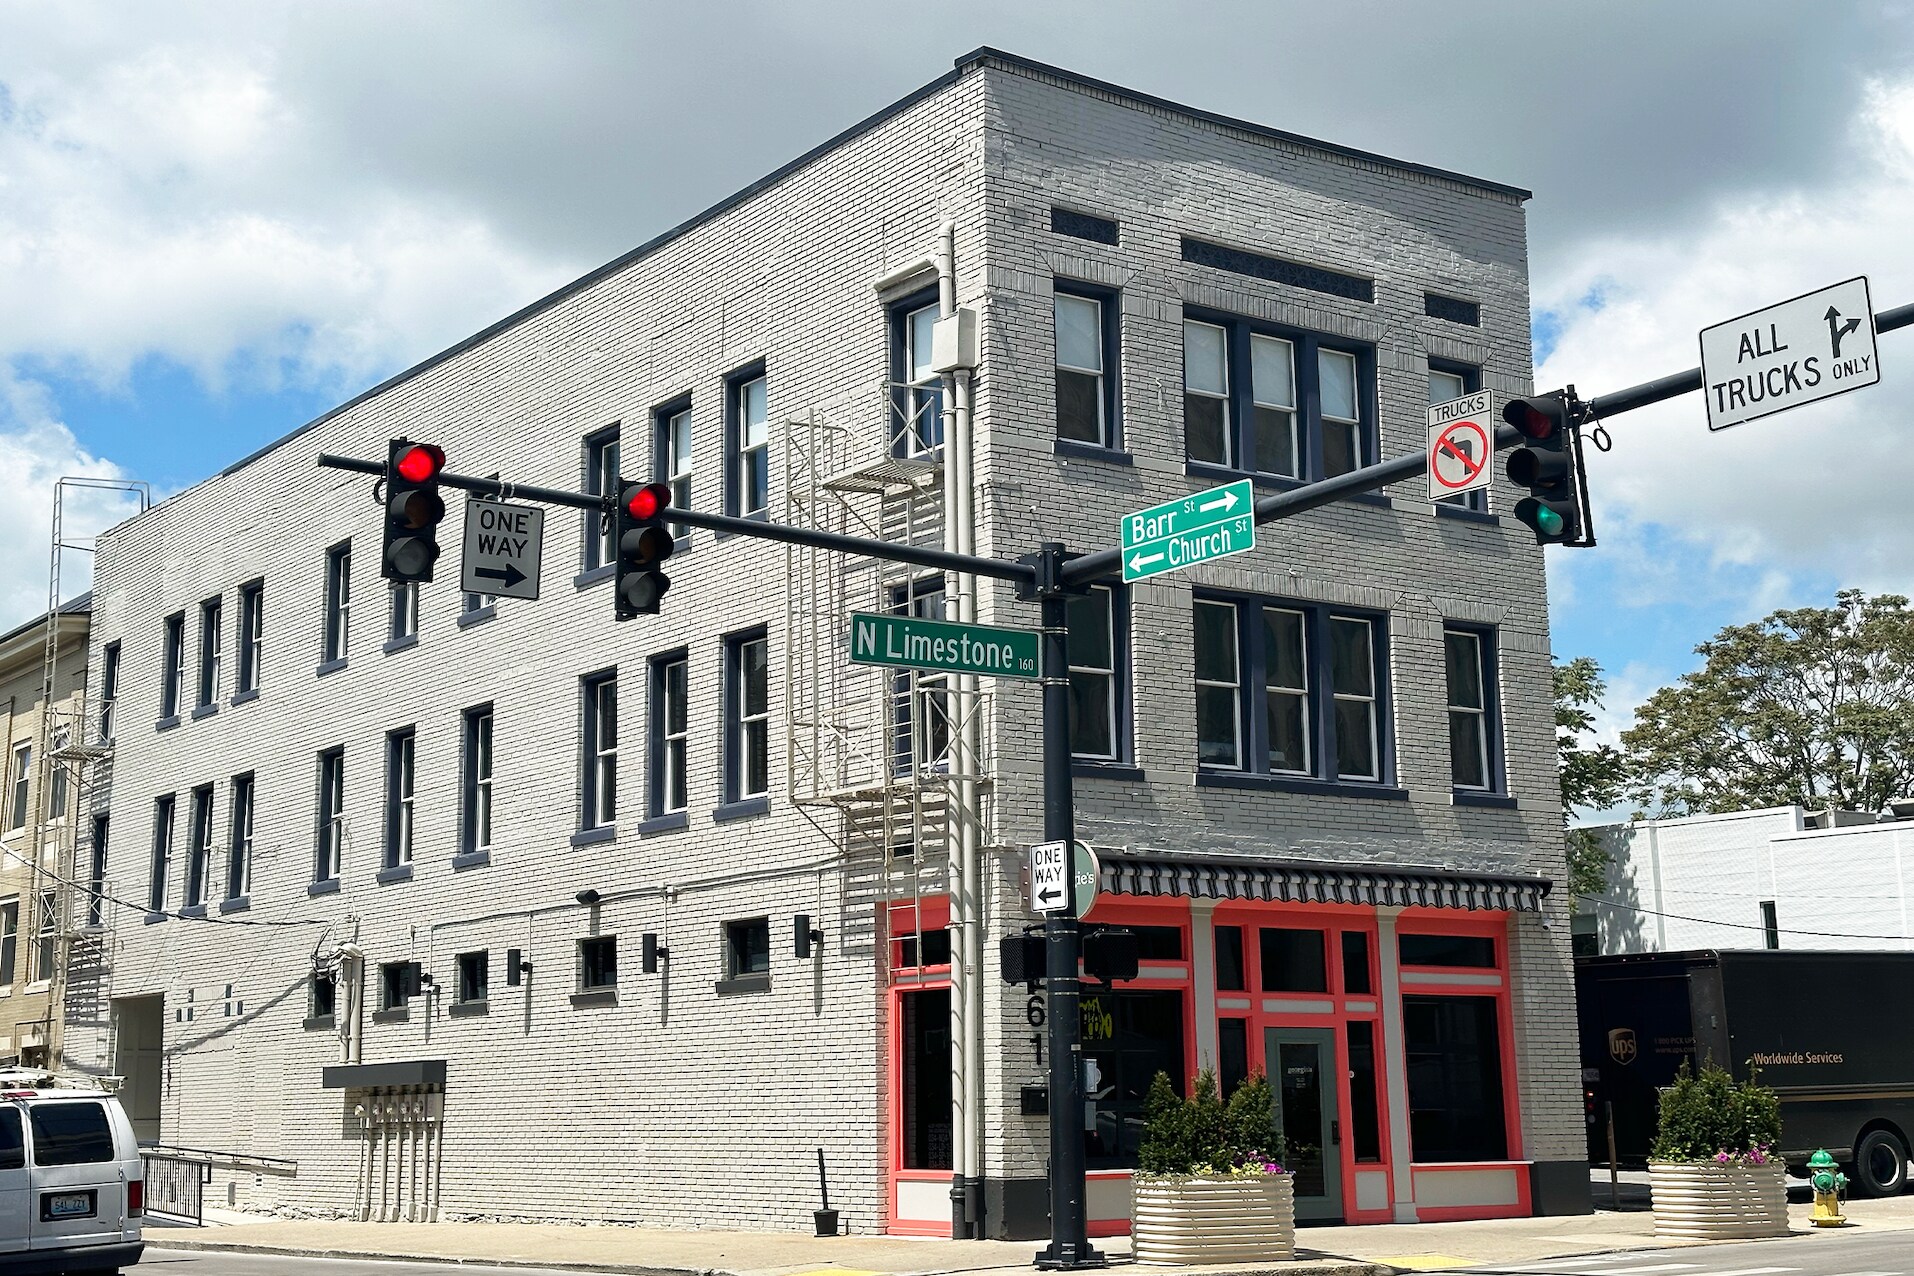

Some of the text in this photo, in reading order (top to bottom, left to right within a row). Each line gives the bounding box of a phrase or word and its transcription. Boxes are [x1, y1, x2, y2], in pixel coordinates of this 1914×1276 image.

[1737, 323, 1789, 364] ALL
[1832, 354, 1871, 380] ONLY
[1712, 357, 1821, 413] TRUCKS
[1434, 396, 1485, 421] TRUCKS
[480, 509, 529, 535] ONE
[1132, 500, 1195, 543] Barr St
[478, 533, 529, 559] WAY
[1168, 519, 1248, 565] Church St
[857, 621, 1034, 671] N Limestone 160
[1035, 847, 1061, 866] ONE
[1034, 865, 1063, 884] WAY
[1611, 1039, 1635, 1060] ups
[1754, 1051, 1844, 1065] Worldwide Services
